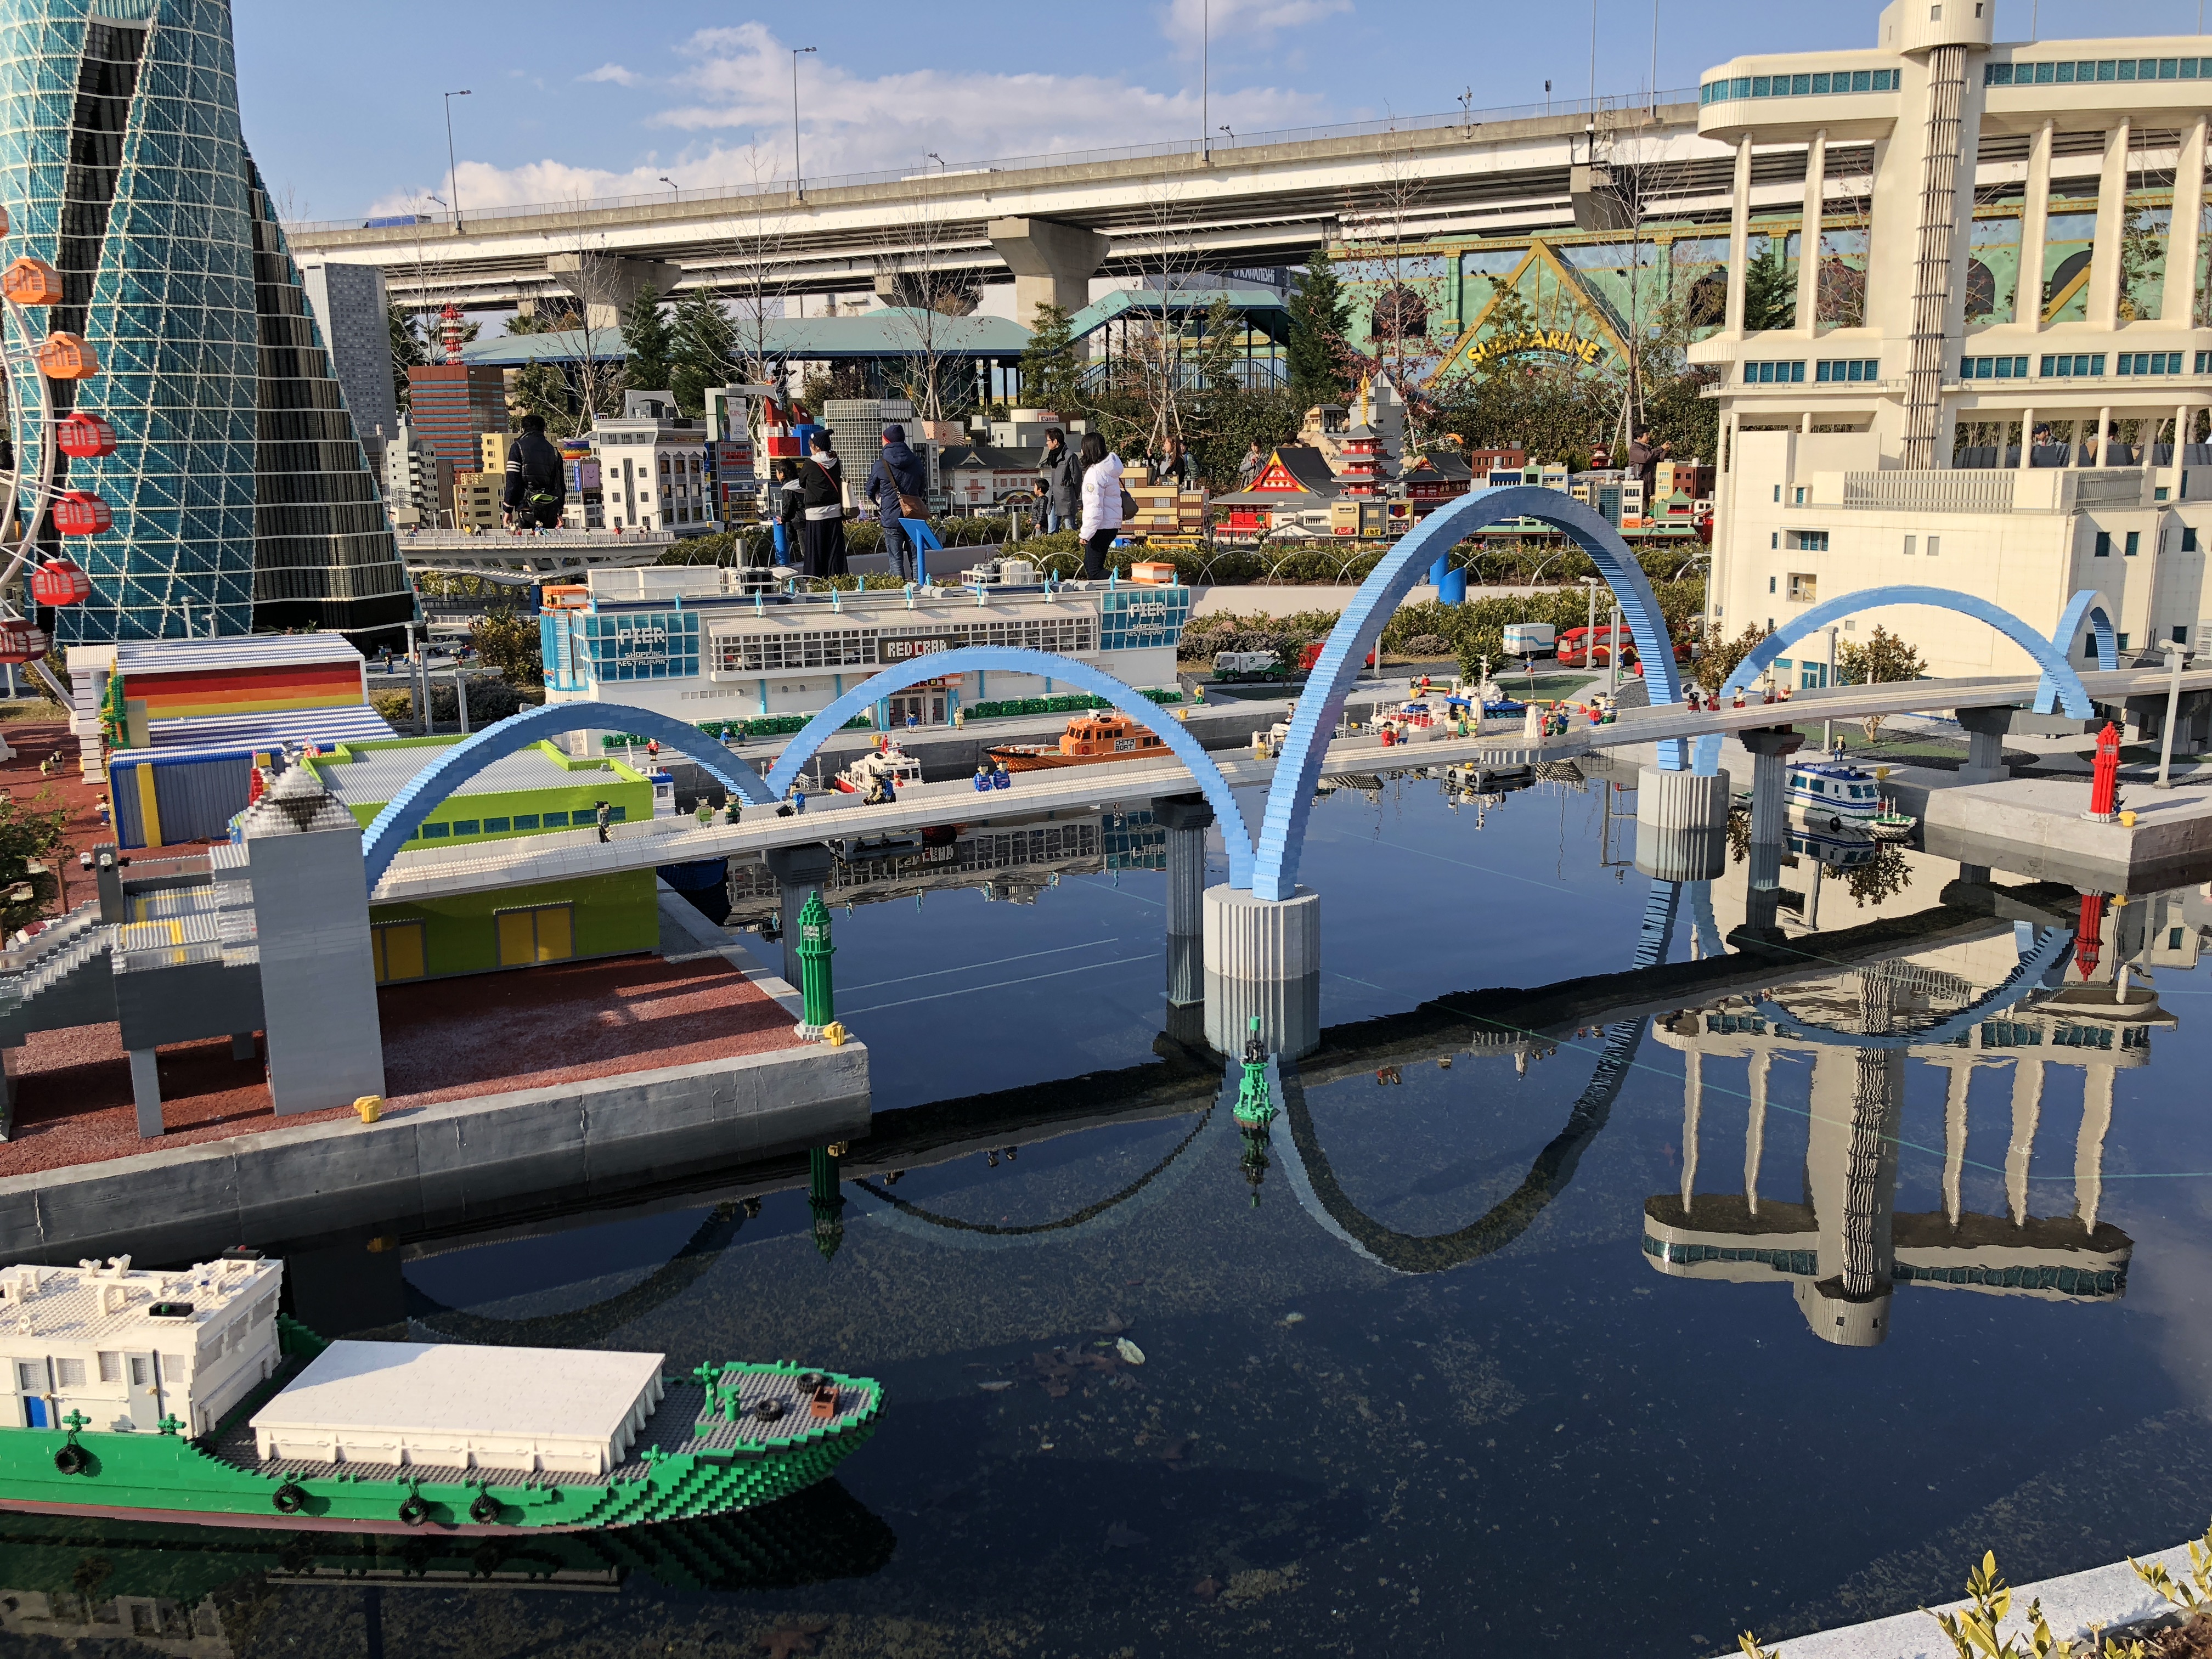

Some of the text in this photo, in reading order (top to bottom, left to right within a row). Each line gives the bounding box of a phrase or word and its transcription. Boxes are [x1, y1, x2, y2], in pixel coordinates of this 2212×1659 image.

[1131, 602, 1165, 618] PIER
[620, 627, 665, 645] PIER
[888, 639, 946, 657] RED CRAB
[616, 658, 671, 667] RESTAURANT
